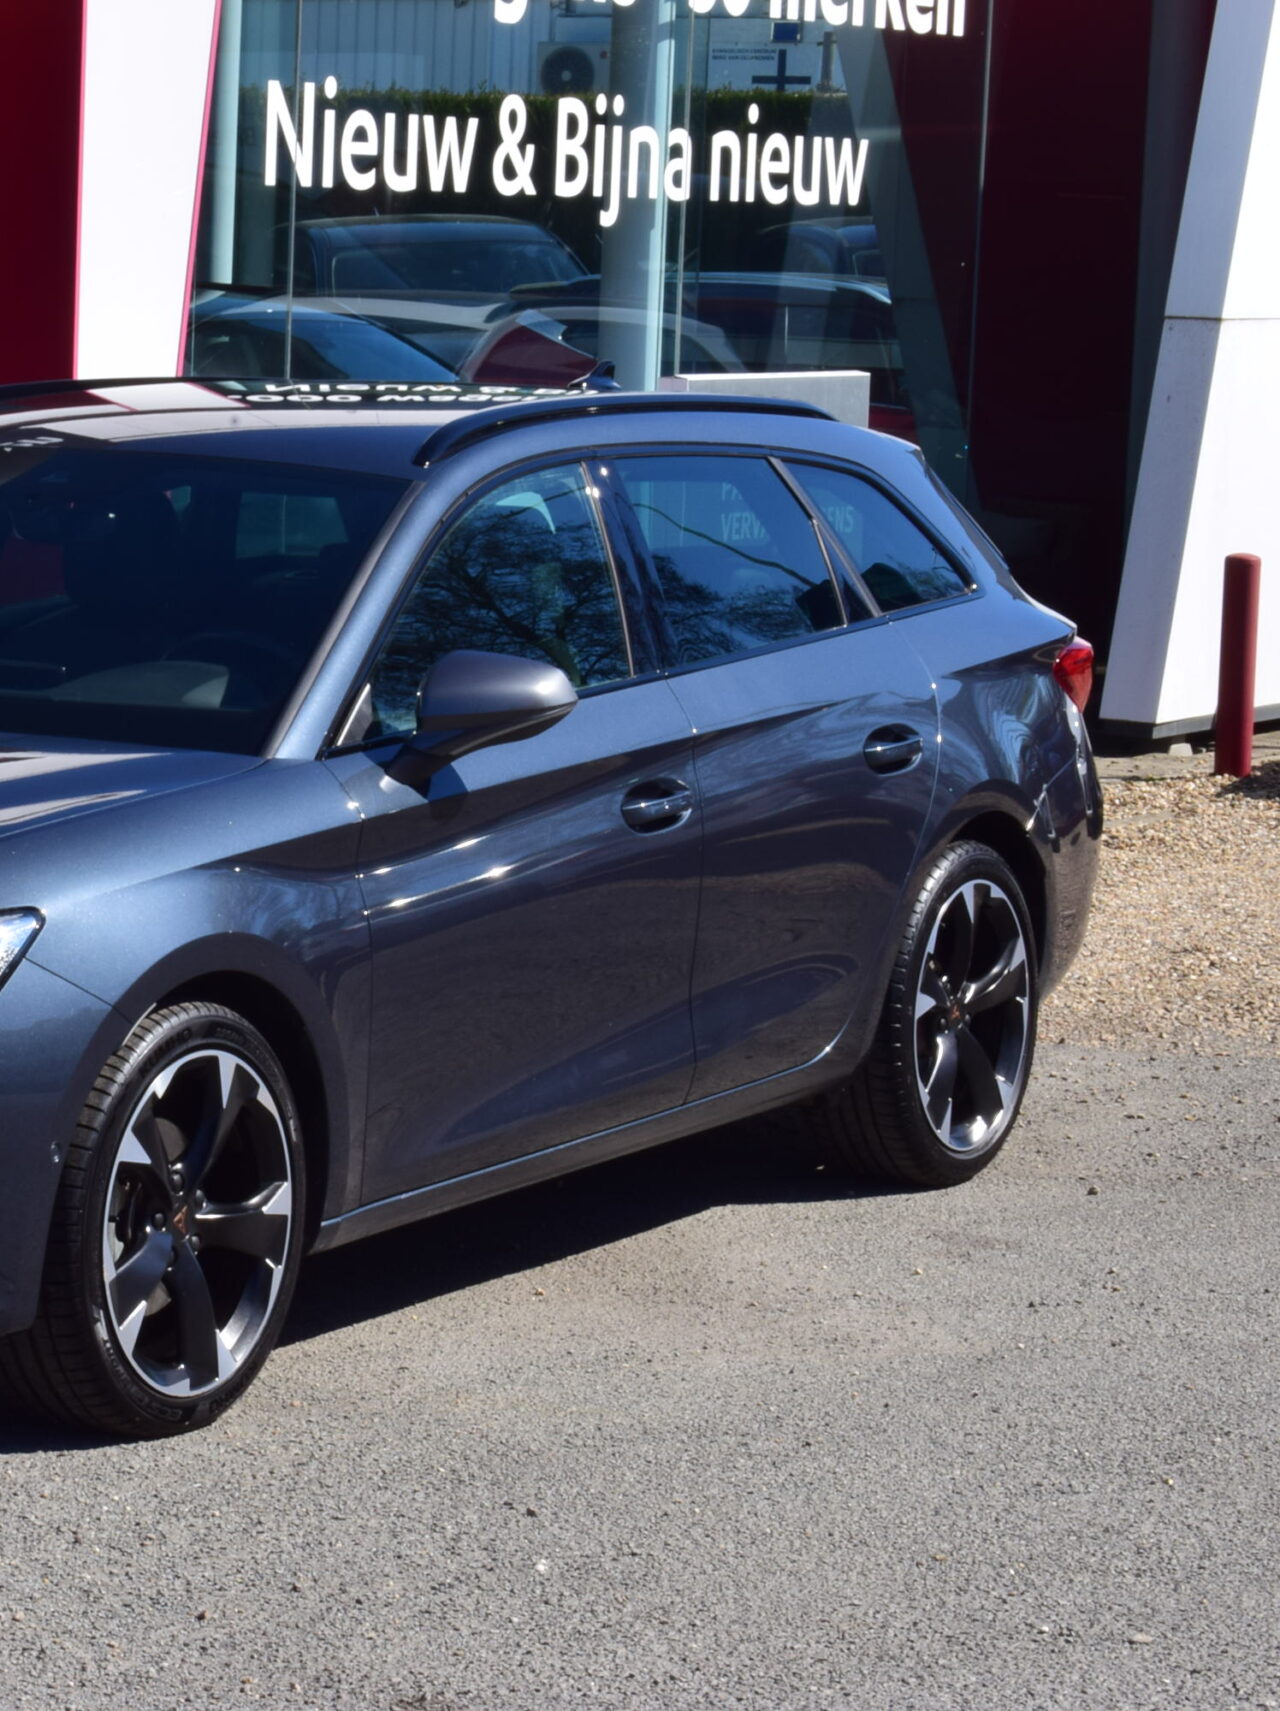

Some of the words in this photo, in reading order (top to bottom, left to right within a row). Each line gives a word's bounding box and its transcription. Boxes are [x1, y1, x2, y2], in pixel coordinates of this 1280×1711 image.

[265, 76, 477, 193] Nieuw
[493, 94, 535, 196] &
[554, 93, 691, 228] Bijna
[709, 103, 869, 206] nieuw
